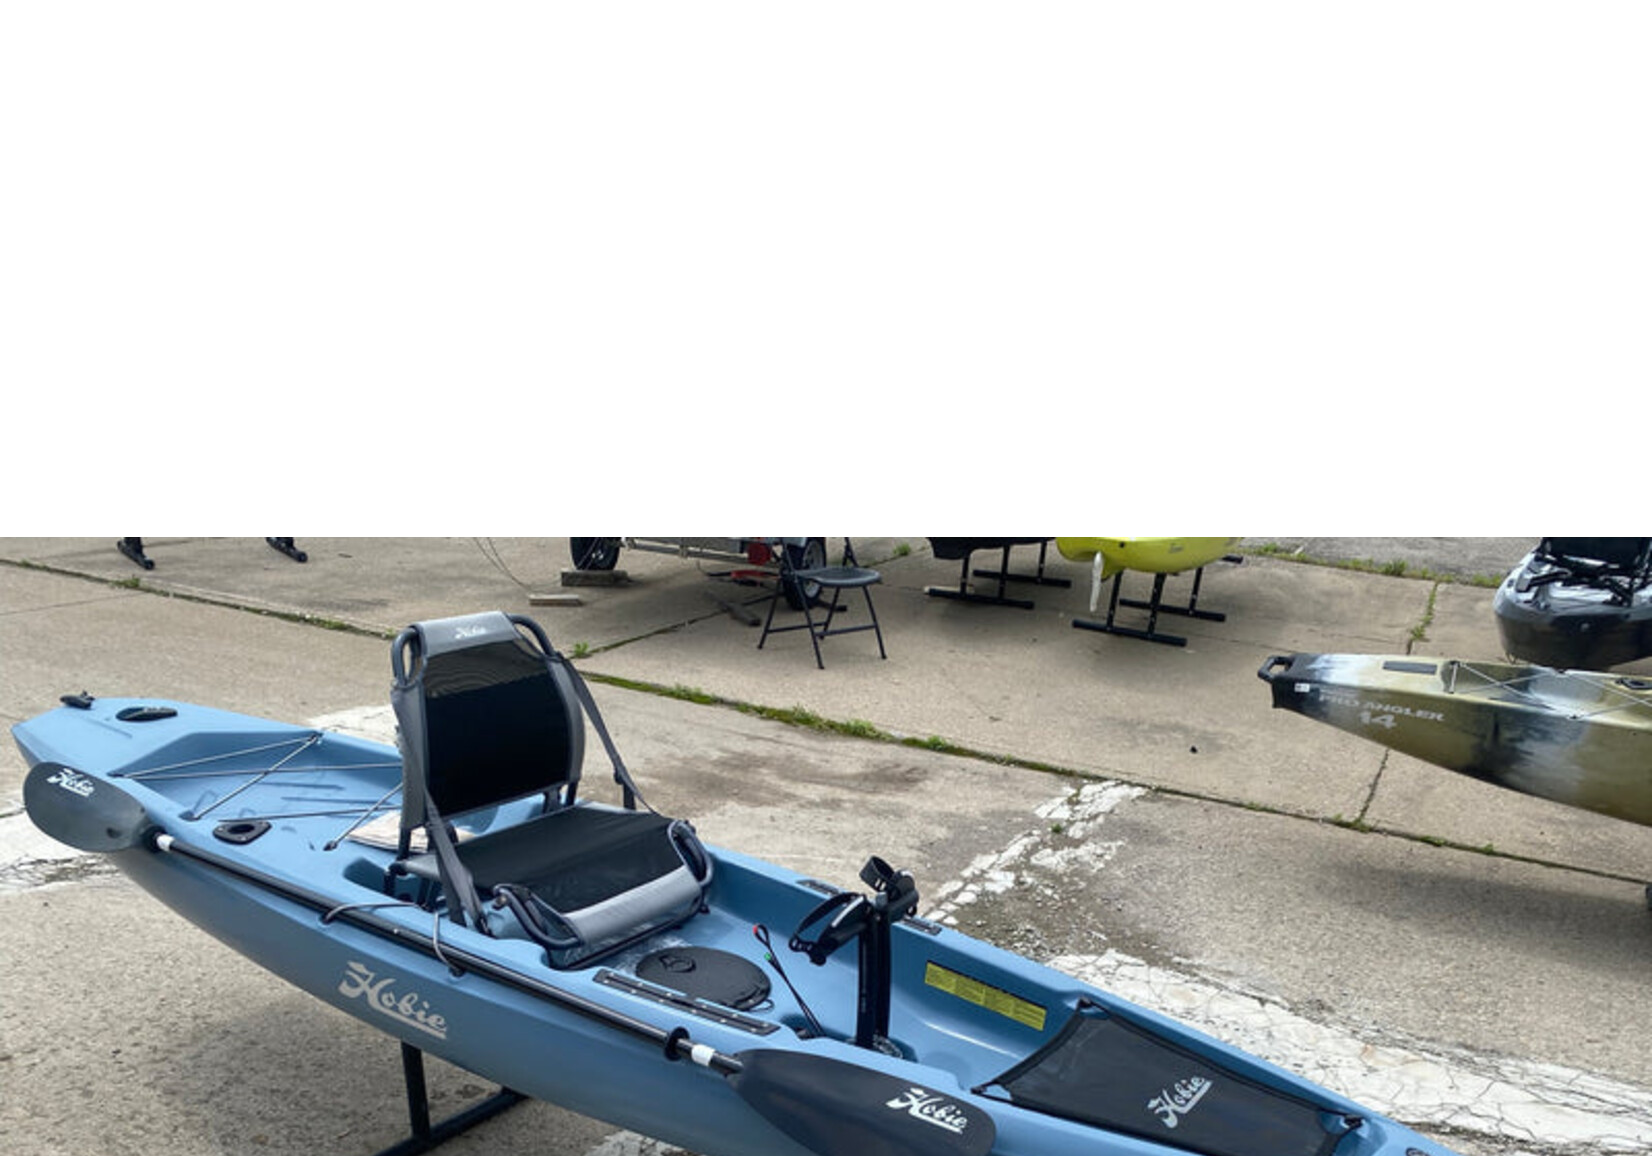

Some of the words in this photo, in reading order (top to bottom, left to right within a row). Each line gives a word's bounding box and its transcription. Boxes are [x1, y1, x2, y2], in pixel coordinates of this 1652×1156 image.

[1319, 694, 1359, 707] PRO
[1363, 701, 1444, 721] ANGLER
[1360, 711, 1396, 729] 14
[46, 767, 95, 797] Hobie
[338, 960, 447, 1039] Hobie
[886, 1087, 968, 1134] Hobie
[1147, 1075, 1212, 1128] Hobie
